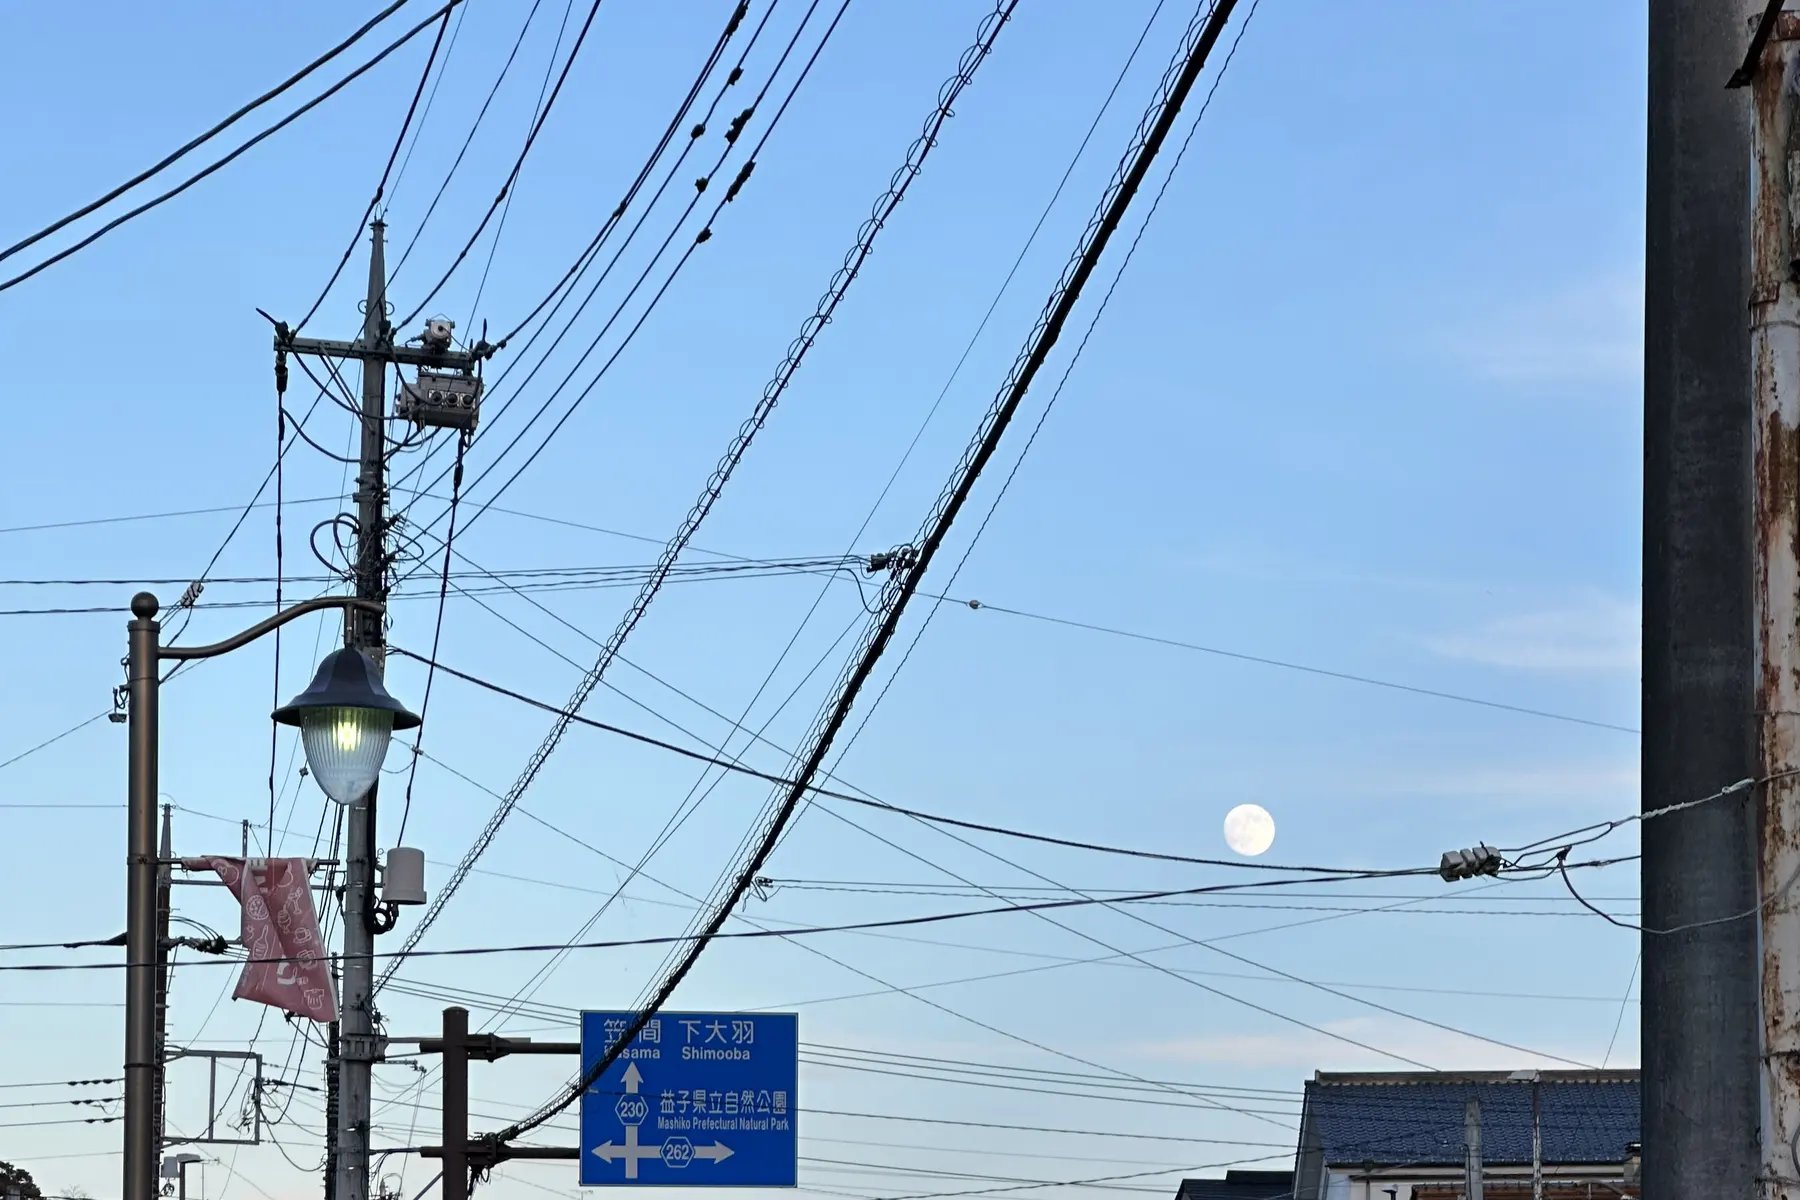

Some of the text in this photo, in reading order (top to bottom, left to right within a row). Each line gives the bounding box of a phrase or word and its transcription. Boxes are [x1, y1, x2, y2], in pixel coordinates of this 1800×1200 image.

[678, 1019, 754, 1044] 下大羽
[682, 1046, 750, 1060] Shimooba
[620, 1101, 644, 1118] 230
[660, 1088, 787, 1115] 益子県立自然公園
[657, 1116, 790, 1131] Mashiko Prefectural Natural Park
[665, 1144, 690, 1160] 262
